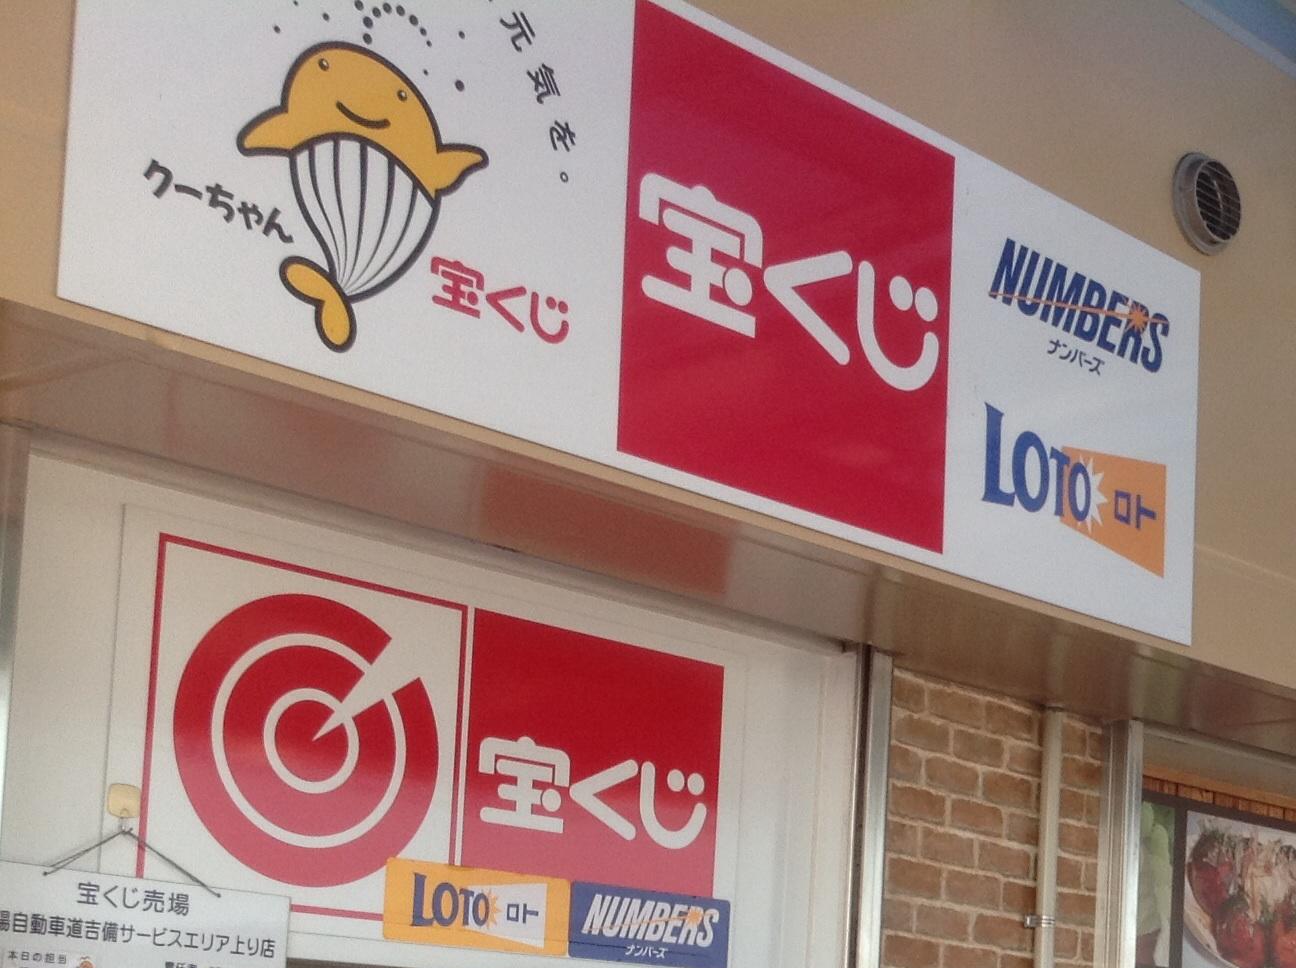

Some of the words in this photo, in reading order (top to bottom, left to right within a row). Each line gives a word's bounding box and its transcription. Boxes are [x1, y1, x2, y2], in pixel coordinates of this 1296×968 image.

[143, 158, 294, 244] クーちゃん
[430, 255, 570, 344] 宝くじ
[640, 171, 939, 392] 宝くじ
[989, 237, 1171, 374] NUMBERS
[1046, 338, 1107, 376] ナンバーズ
[981, 401, 1093, 524] LOTO
[1113, 487, 1158, 530] ロト
[478, 736, 708, 850] 宝くじ
[76, 881, 190, 916] 宝くじ売場
[410, 871, 491, 928] LOTO
[506, 903, 539, 925] ロト
[581, 893, 720, 948] NUMBERS
[8, 951, 68, 966] 本日の担当
[625, 945, 669, 960] ナンバーズ
